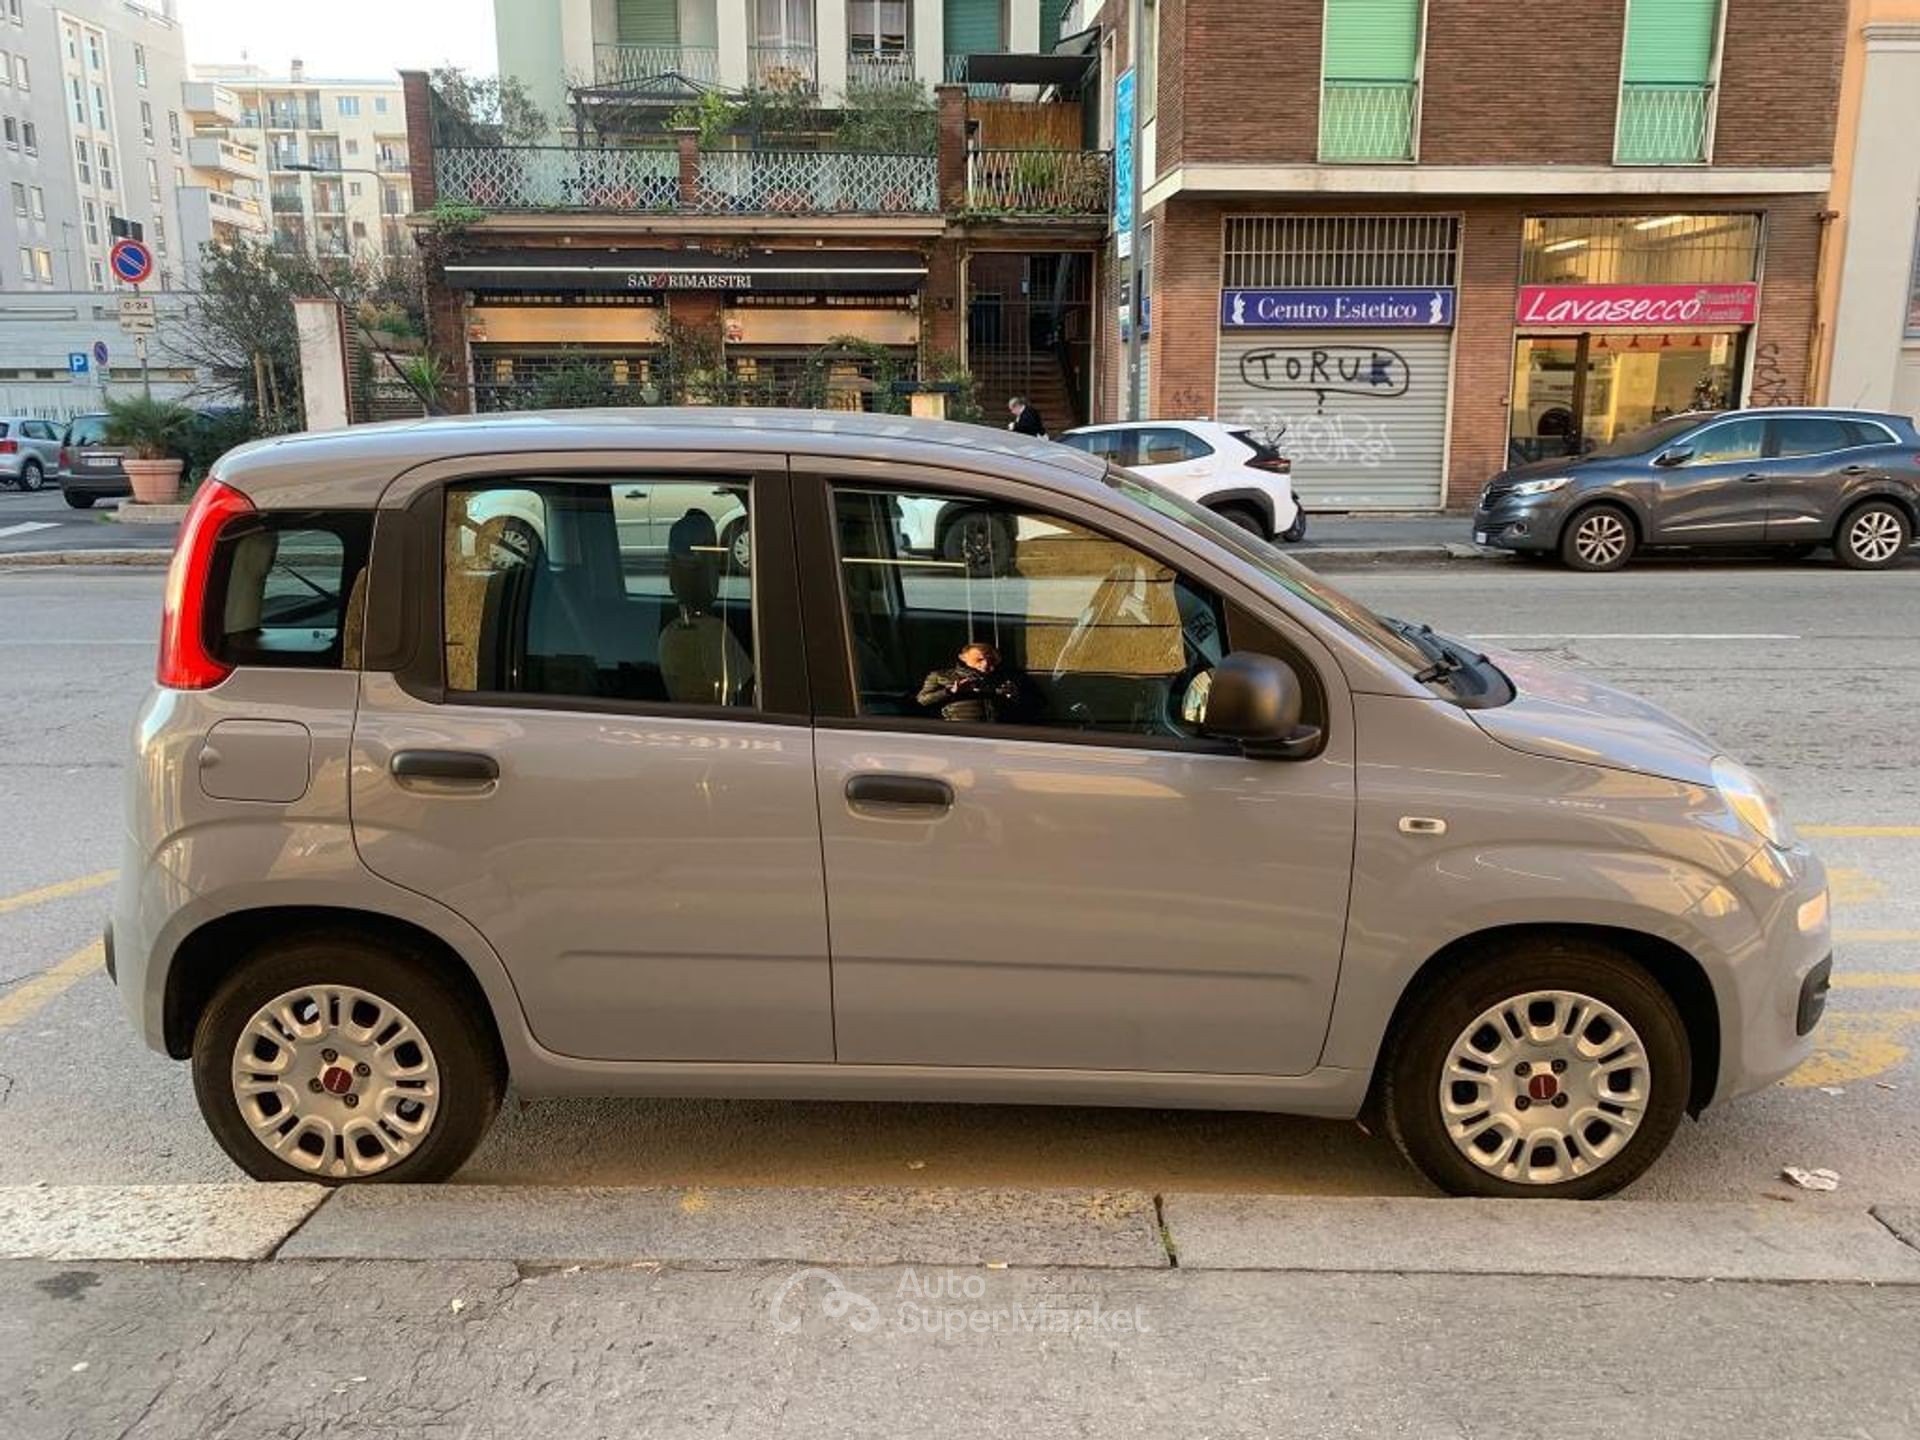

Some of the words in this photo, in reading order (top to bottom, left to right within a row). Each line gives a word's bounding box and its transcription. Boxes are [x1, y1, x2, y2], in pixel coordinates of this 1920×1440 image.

[1257, 297, 1328, 320] Centro
[1334, 297, 1417, 320] Estetico
[1524, 290, 1701, 322] Lavasecco
[72, 357, 85, 371] P
